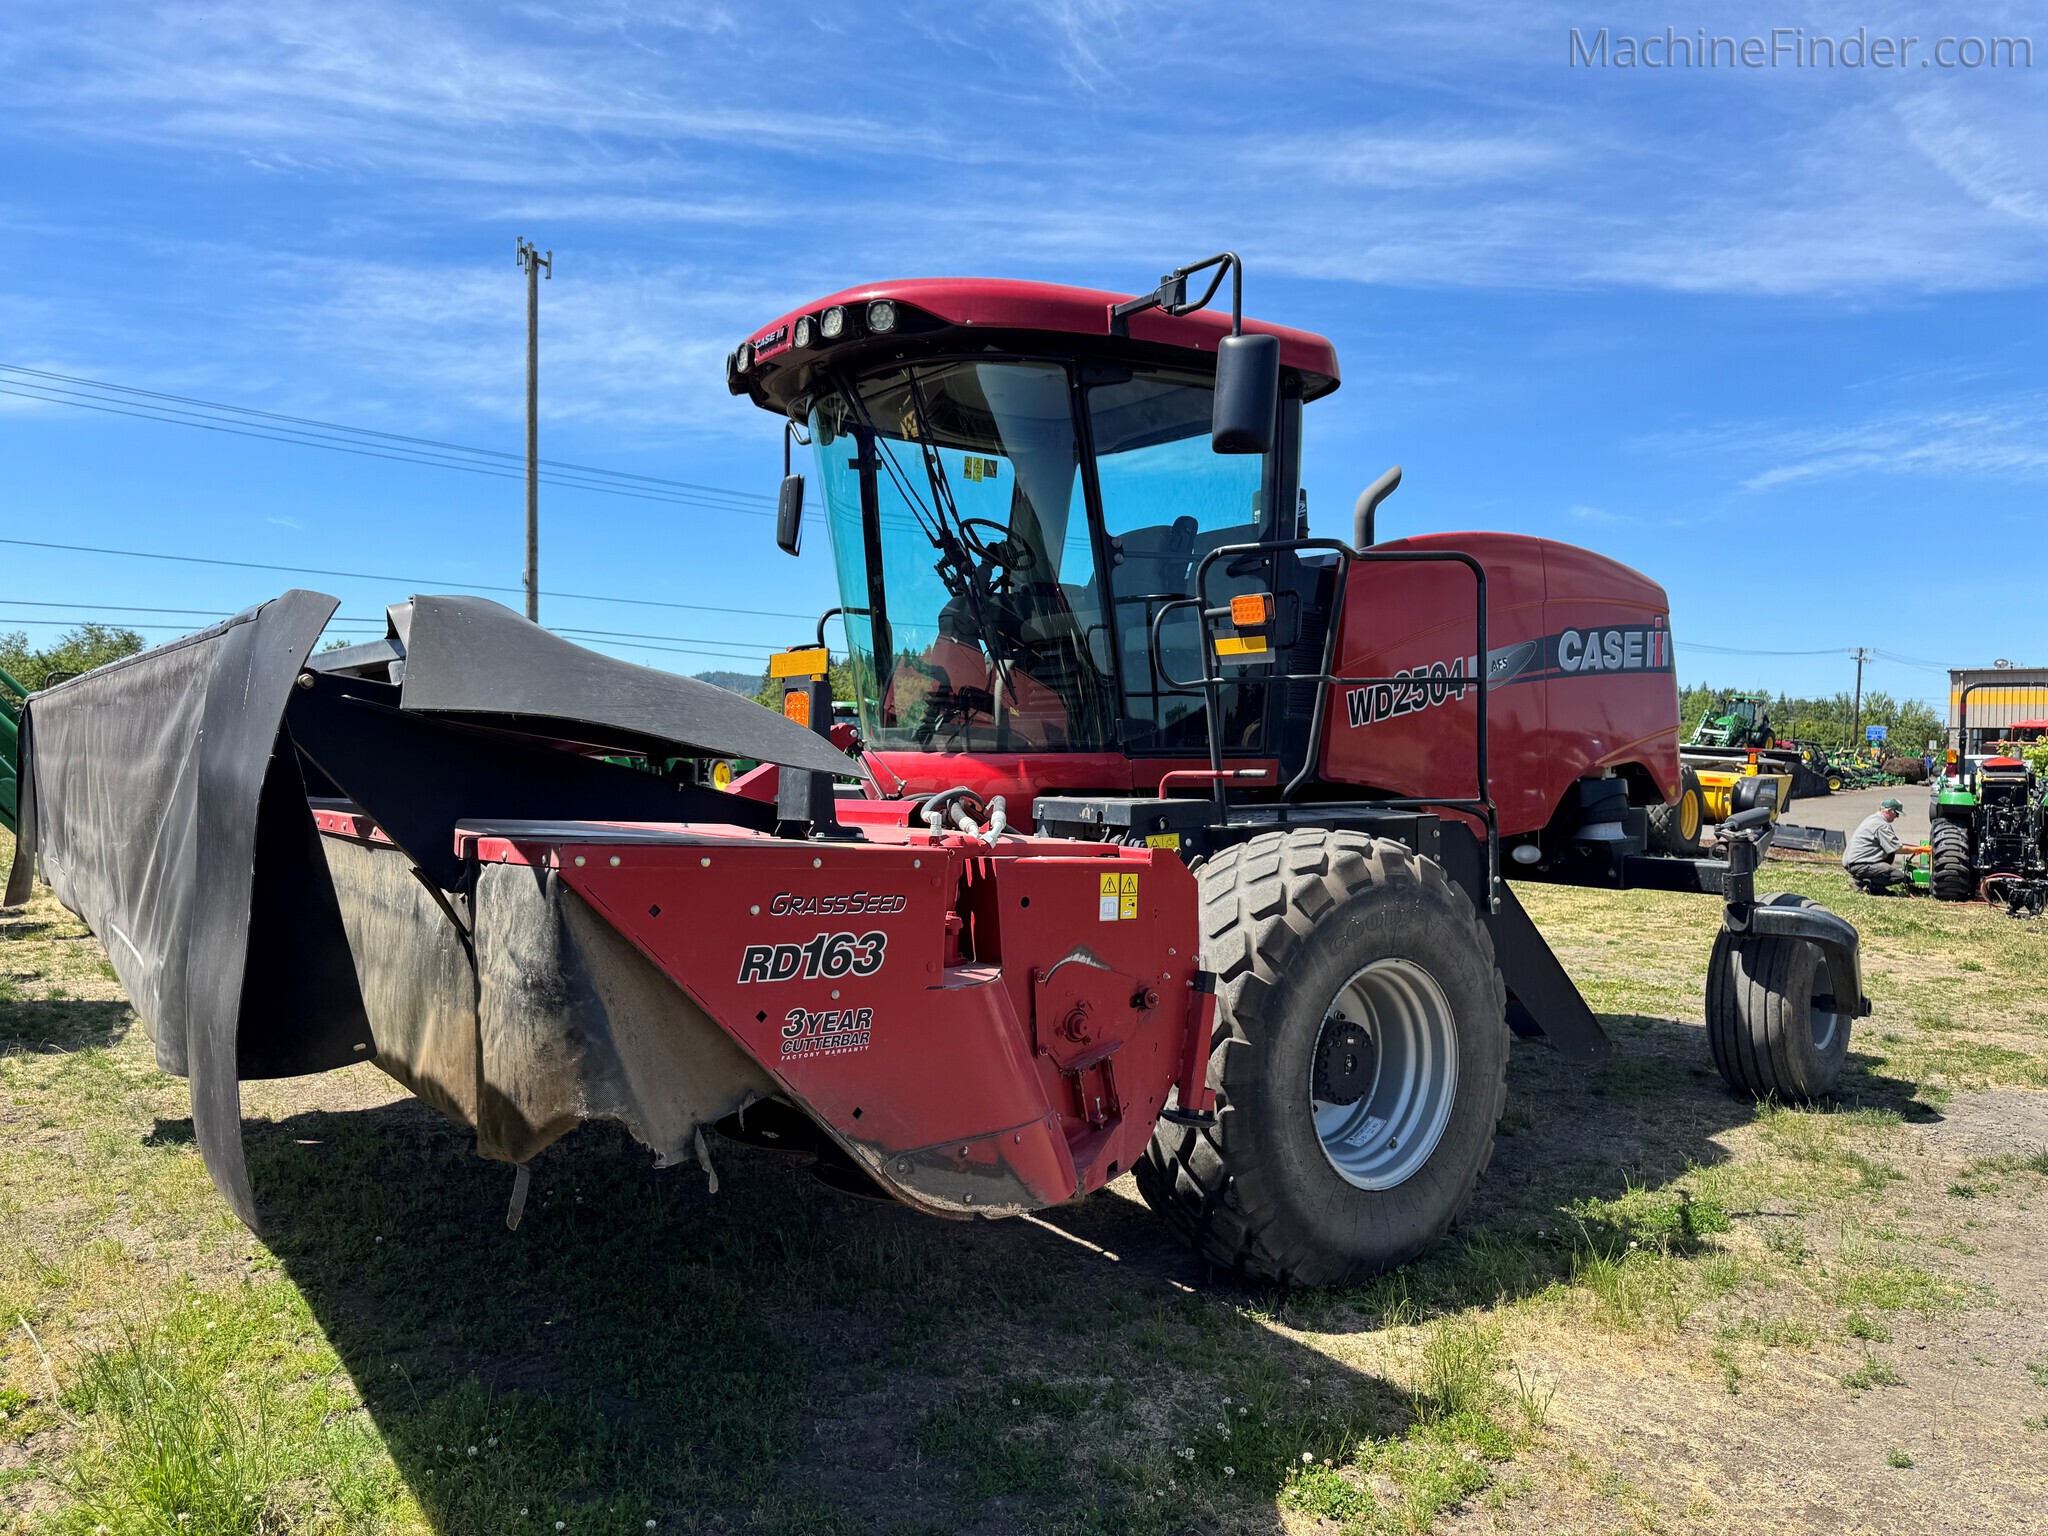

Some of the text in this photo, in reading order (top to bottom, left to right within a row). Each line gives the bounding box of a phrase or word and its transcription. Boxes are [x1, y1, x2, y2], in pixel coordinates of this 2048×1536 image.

[1491, 657, 1508, 672] AFS
[1558, 630, 1643, 672] CASE
[1346, 656, 1467, 729] WD2504
[737, 930, 888, 984] RD163
[781, 1031, 871, 1055] CUTTERBAR
[781, 1045, 869, 1061] FACTORY WARRANTY
